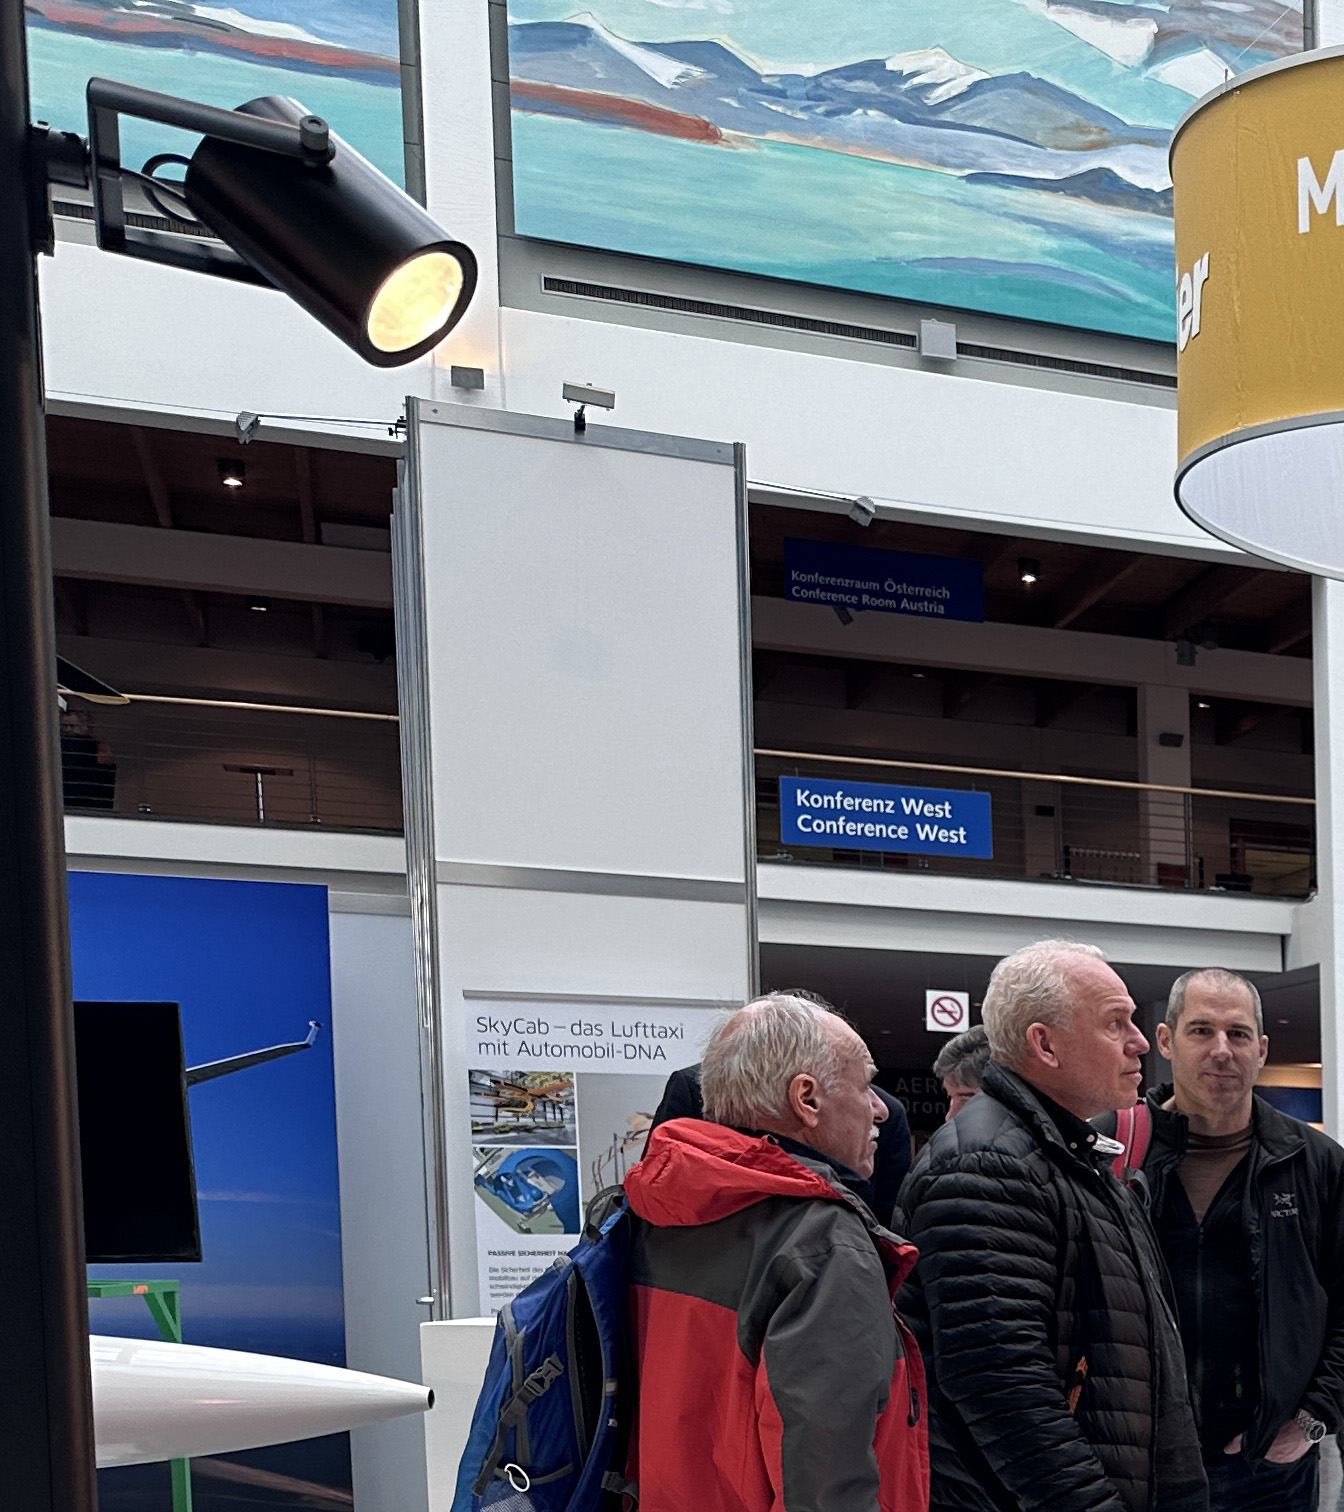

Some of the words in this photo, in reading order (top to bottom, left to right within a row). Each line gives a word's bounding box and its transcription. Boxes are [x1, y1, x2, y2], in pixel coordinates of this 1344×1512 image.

[1176, 251, 1211, 354] er
[791, 569, 880, 592] Konferenzraum
[884, 578, 951, 600] Österreich
[791, 586, 859, 605] Conference
[862, 594, 897, 609] Room
[900, 598, 946, 615] Austria
[796, 788, 895, 814] Konferenz
[901, 797, 953, 819] West
[796, 814, 909, 840] Conference
[915, 823, 967, 845] West
[476, 1016, 549, 1036] SkyCab
[570, 1019, 604, 1037] das
[611, 1021, 684, 1039] Lufttaxi
[478, 1038, 509, 1056] mit
[517, 1040, 667, 1061] Automobil-DNA
[895, 1077, 945, 1094] AER
